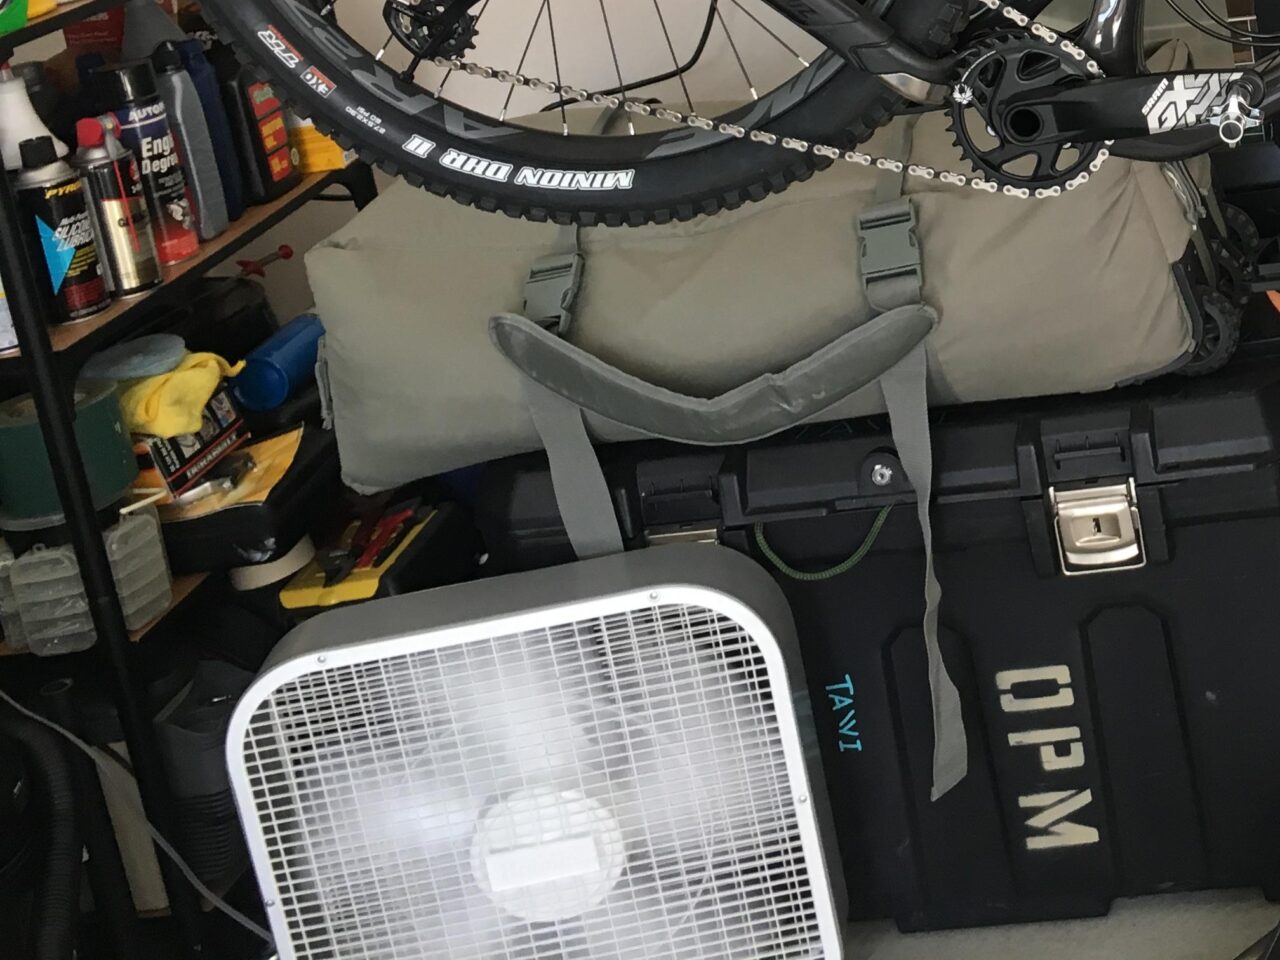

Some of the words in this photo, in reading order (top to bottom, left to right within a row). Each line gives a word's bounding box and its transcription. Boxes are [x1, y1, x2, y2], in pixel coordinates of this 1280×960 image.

[1141, 77, 1169, 116] SRAM
[438, 148, 514, 182] DHR
[514, 166, 634, 190] MINION
[995, 665, 1099, 849] OPM
